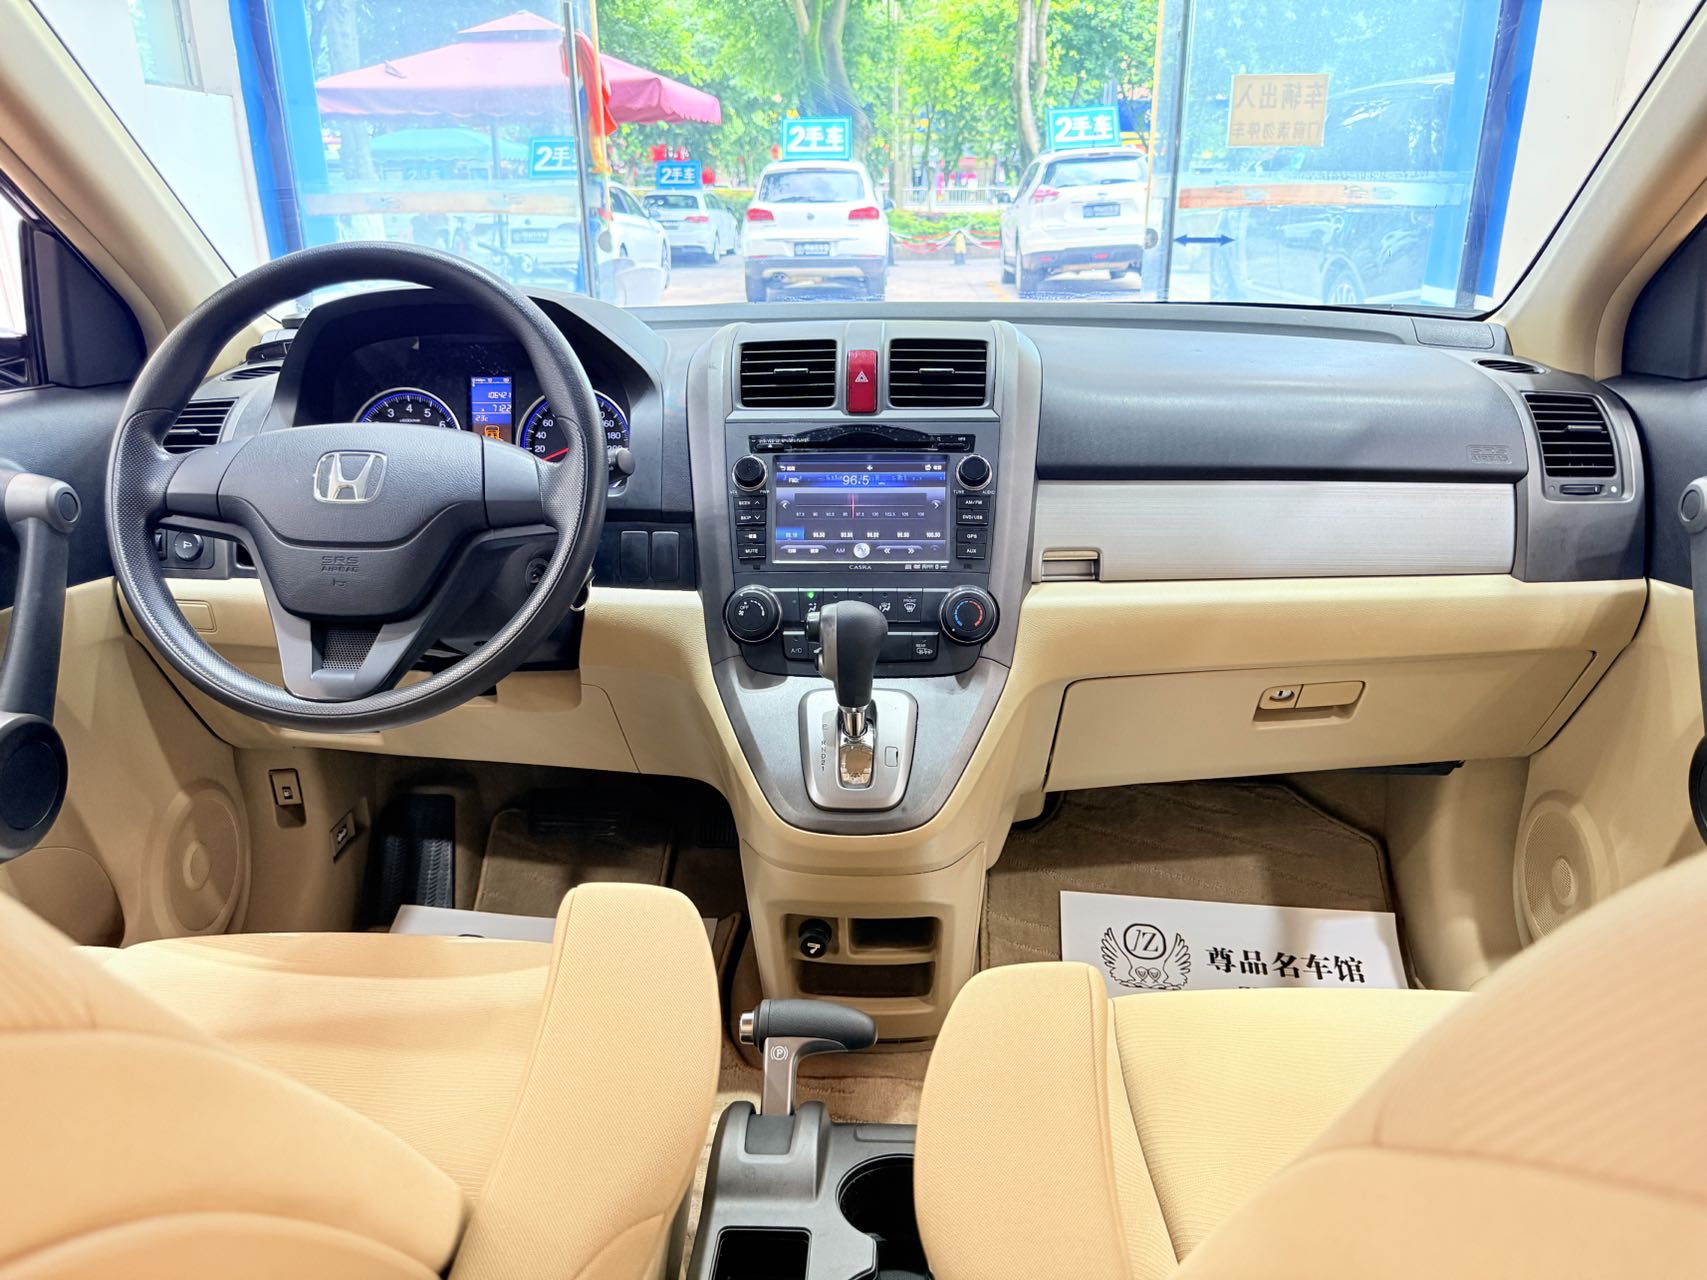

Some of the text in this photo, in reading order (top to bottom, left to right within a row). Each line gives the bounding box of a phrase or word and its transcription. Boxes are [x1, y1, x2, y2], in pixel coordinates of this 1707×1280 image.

[1055, 114, 1113, 142] 2手车
[787, 126, 844, 152] 2手车
[534, 145, 577, 172] 2手
[659, 167, 696, 184] 2手车
[387, 408, 395, 418] 3
[405, 403, 413, 413] 4
[423, 408, 432, 418] 5
[542, 419, 554, 427] 60
[535, 431, 547, 440] 40
[606, 432, 621, 440] 180
[534, 444, 546, 453] 20
[842, 474, 870, 486] 96.5
[320, 555, 360, 564] SRS
[1205, 946, 1366, 984] 尊品名车馆
